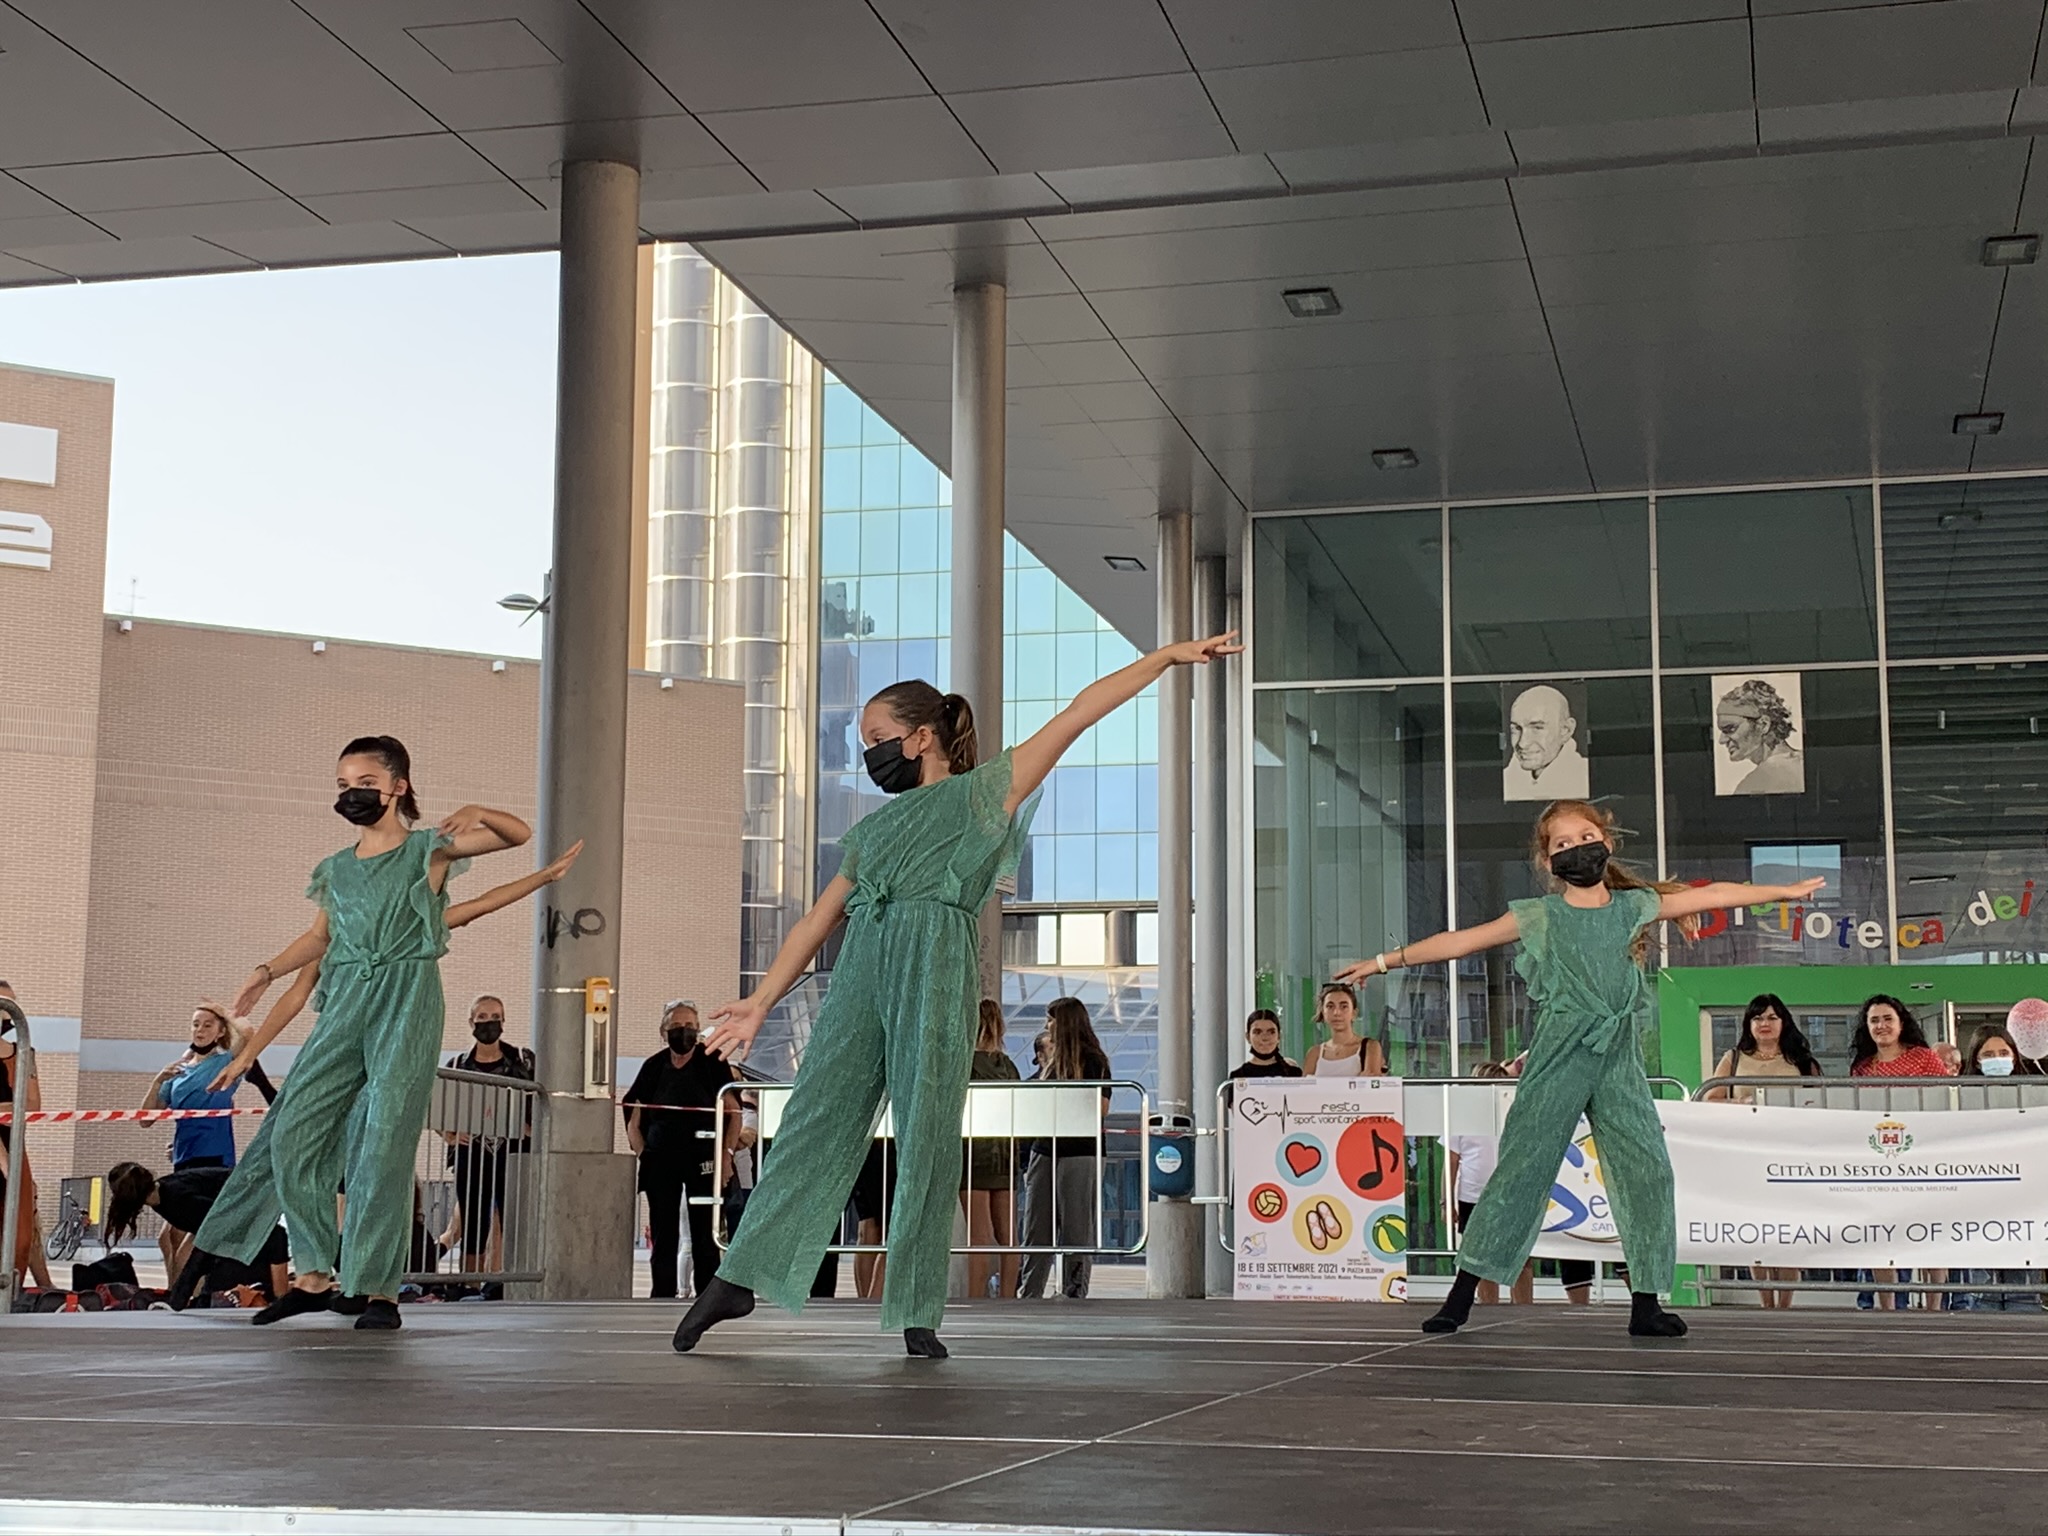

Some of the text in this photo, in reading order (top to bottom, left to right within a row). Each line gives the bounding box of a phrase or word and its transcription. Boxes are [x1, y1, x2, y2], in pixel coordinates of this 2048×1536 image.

[1967, 880, 2034, 926] dei
[1843, 1163, 1893, 1177] SESTO
[1897, 1162, 1930, 1176] SAN
[1935, 1162, 2021, 1176] GIOVANNI
[1689, 1221, 1831, 1245] EUROPEAN
[1841, 1223, 1897, 1244] CITY
[1905, 1222, 1943, 1243] OF
[1950, 1220, 2035, 1243] SPORT
[1238, 1262, 1247, 1272] 18
[1267, 1262, 1315, 1273] SETTEMBRE
[1317, 1262, 1339, 1274] 2021
